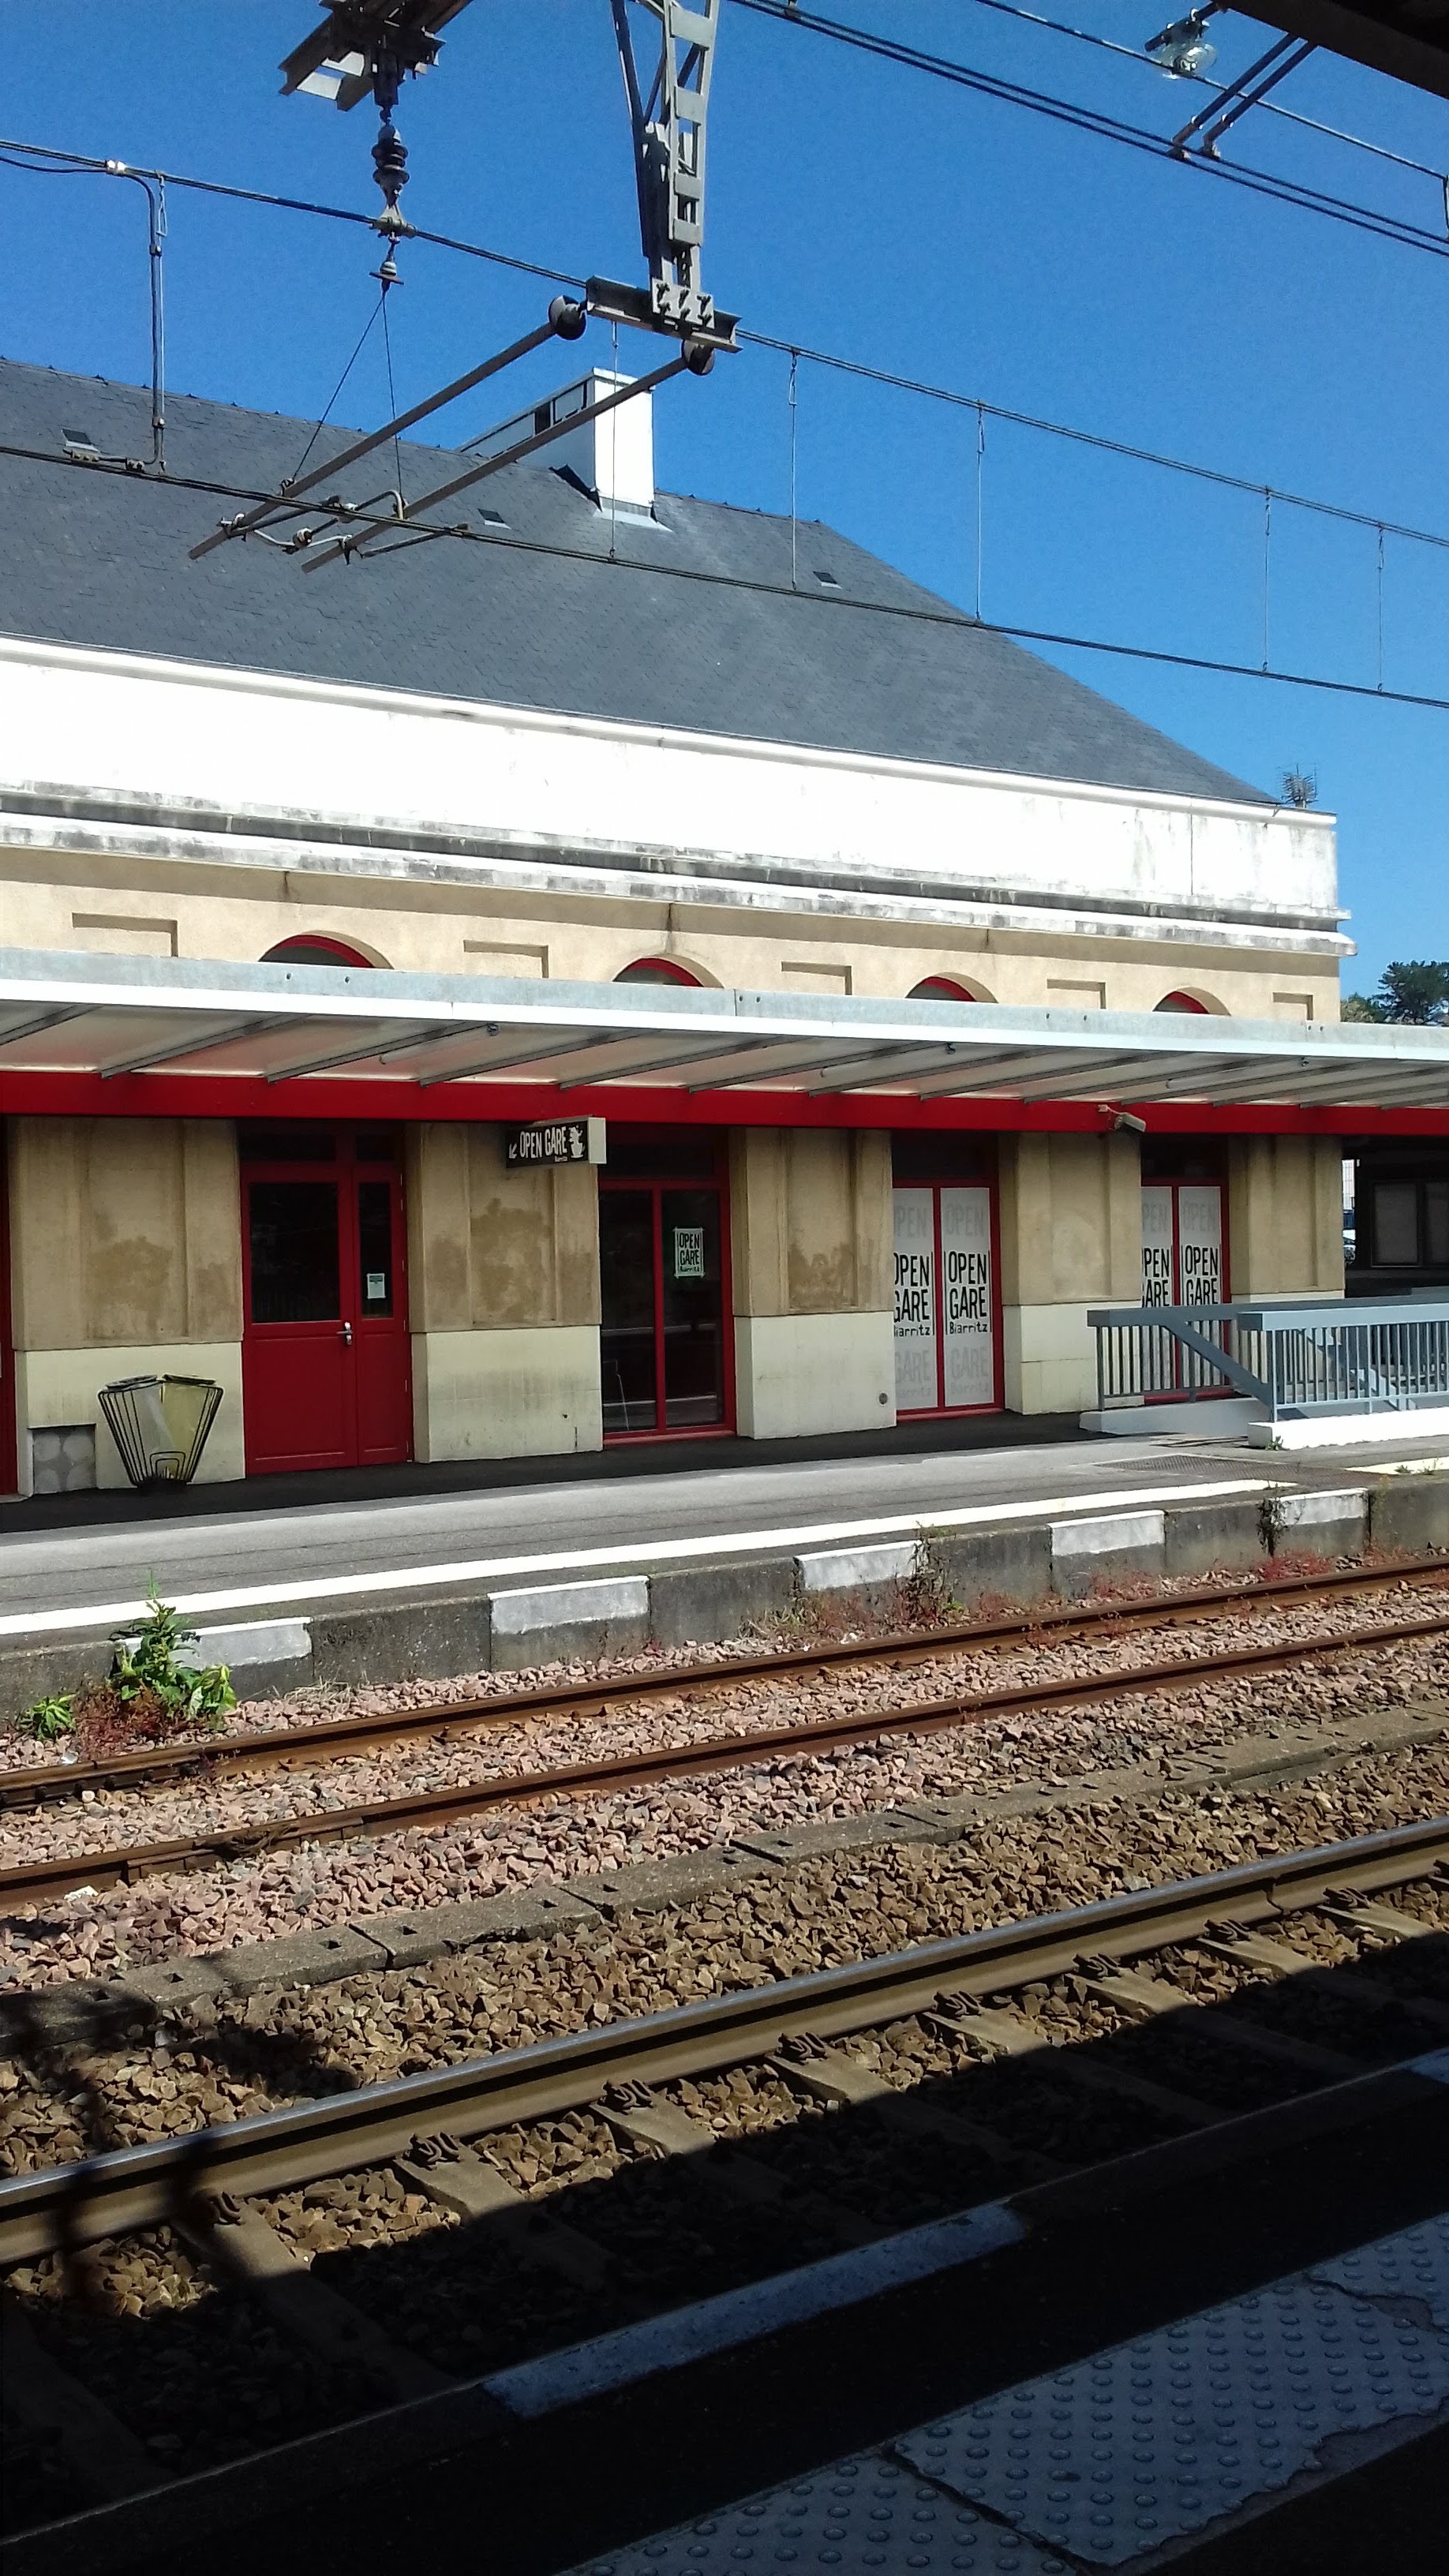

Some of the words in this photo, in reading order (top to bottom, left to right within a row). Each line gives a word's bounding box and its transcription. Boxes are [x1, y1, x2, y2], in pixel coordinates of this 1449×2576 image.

[520, 1131, 542, 1159] OPEN
[545, 1126, 567, 1156] GARE
[680, 1233, 700, 1249] OPEN
[680, 1249, 699, 1265] GARE
[949, 1251, 987, 1284] OPEN
[1141, 1248, 1169, 1278] PEN
[1185, 1245, 1218, 1275] OPEN
[949, 1286, 987, 1320] GARE
[1186, 1278, 1219, 1306] GARE
[949, 1321, 987, 1334] Biarritz
